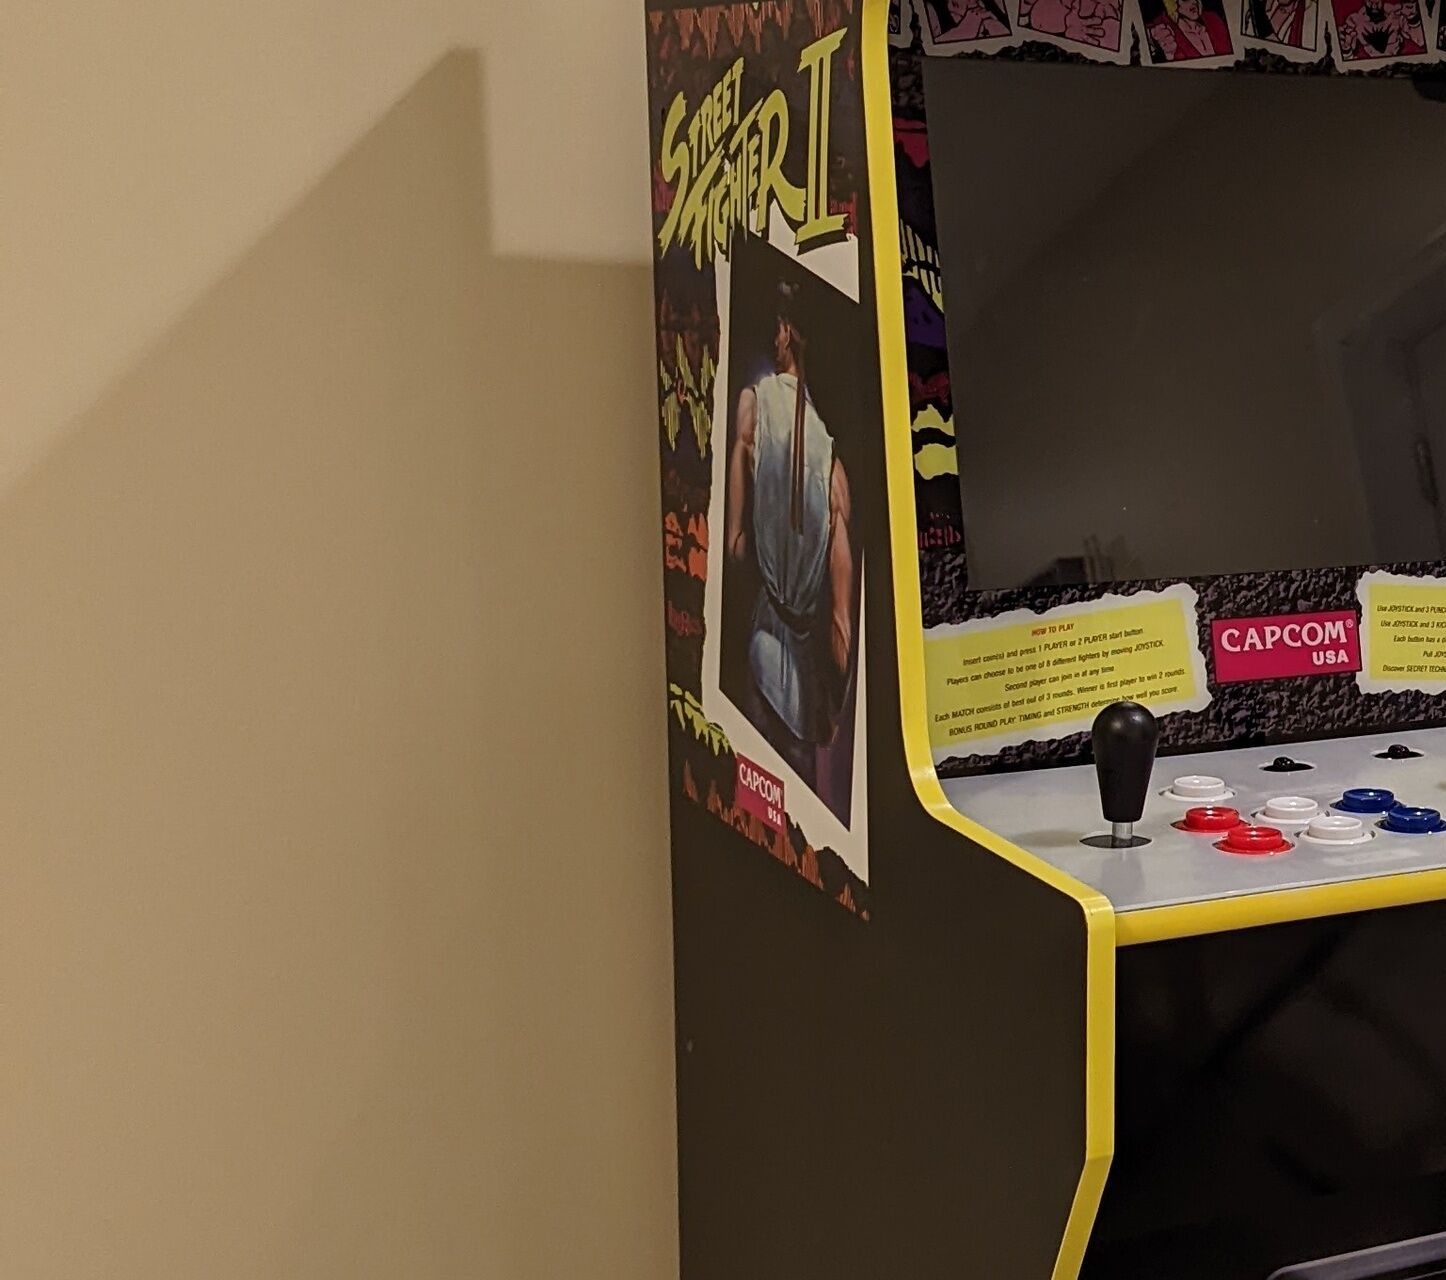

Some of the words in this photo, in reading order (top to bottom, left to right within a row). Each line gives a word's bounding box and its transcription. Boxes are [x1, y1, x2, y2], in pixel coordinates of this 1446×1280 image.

[657, 56, 744, 259] STREET
[677, 88, 806, 271] FIGHTER
[795, 26, 849, 244] II
[963, 656, 981, 666] Insert
[1007, 649, 1018, 658] and
[1020, 647, 1036, 656] press
[1044, 640, 1067, 651] PLAYER
[1084, 633, 1107, 644] PLAYER
[1109, 631, 1122, 640] start
[1032, 628, 1046, 636] HOW
[1058, 623, 1074, 632] PLAY
[947, 676, 969, 685] Players
[984, 670, 1006, 679] choose
[1038, 661, 1045, 669] of
[1052, 656, 1076, 666] different
[1078, 652, 1100, 663] fighters
[1111, 647, 1132, 655] moving
[1312, 649, 1349, 665] USA
[935, 713, 950, 722] Each
[952, 708, 974, 718] MATCH
[976, 704, 1002, 714] consists
[1003, 701, 1010, 709] of
[1011, 699, 1024, 707] best
[1026, 696, 1036, 704] out
[1038, 694, 1044, 702] of
[1077, 685, 1098, 694] Winner
[1120, 678, 1137, 687] player
[1005, 681, 1027, 691] Second
[1029, 679, 1047, 688] player
[1061, 674, 1072, 682] join
[949, 725, 972, 736] BONUS
[974, 720, 998, 731] ROUND
[1019, 711, 1042, 722] TIMING
[1043, 709, 1055, 717] and
[1057, 702, 1089, 715] STRENGTH
[1136, 690, 1147, 699] well
[1149, 690, 1160, 698] you
[739, 763, 781, 808] CAPCOM
[767, 806, 781, 825] USA
